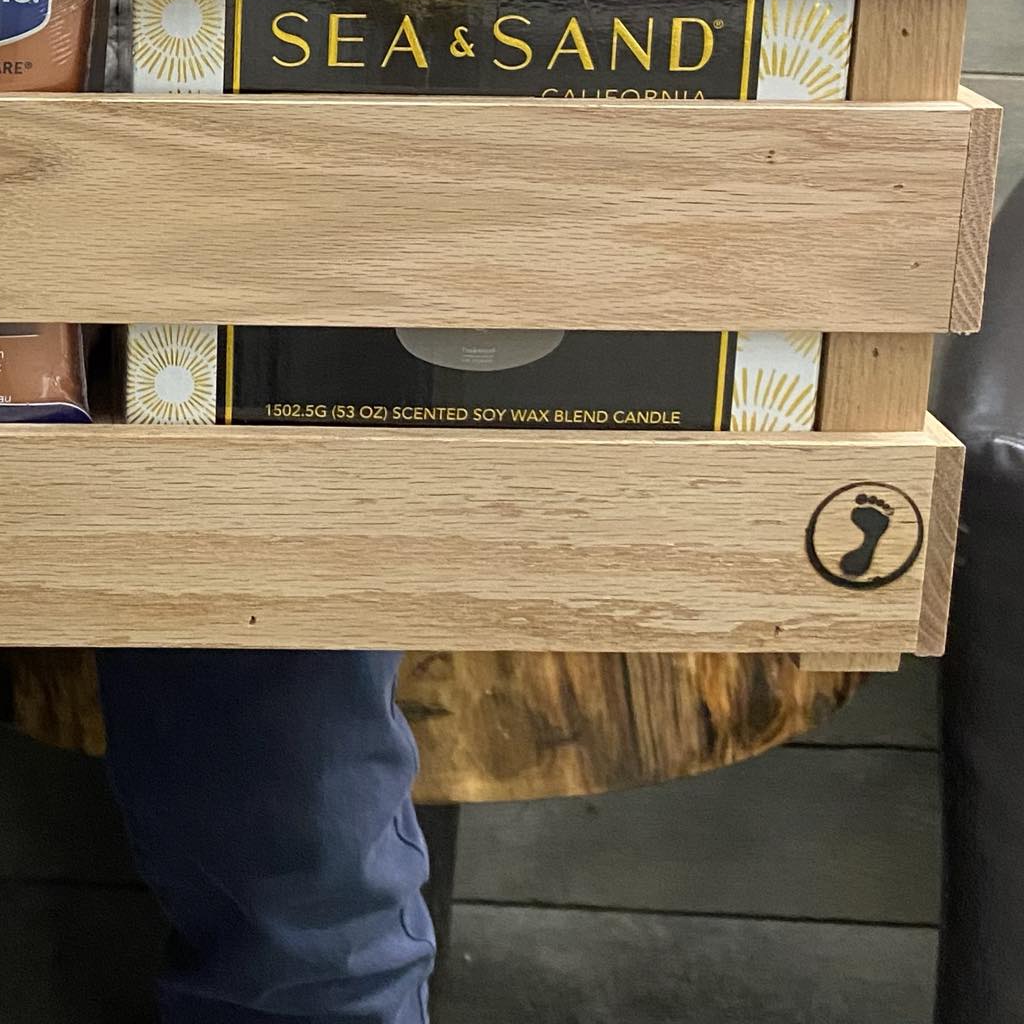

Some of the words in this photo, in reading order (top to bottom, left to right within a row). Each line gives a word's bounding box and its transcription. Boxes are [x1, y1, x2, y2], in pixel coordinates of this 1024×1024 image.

[271, 11, 430, 69] SEA
[448, 25, 476, 59] &
[265, 403, 327, 418] 1502.5G
[331, 405, 355, 420] (53
[359, 405, 388, 421] OZ)
[392, 406, 468, 421] SCENTED
[473, 408, 507, 422] SOY
[511, 409, 550, 423] WAX
[554, 410, 609, 423] BLEND
[613, 410, 681, 425] CANDLE
